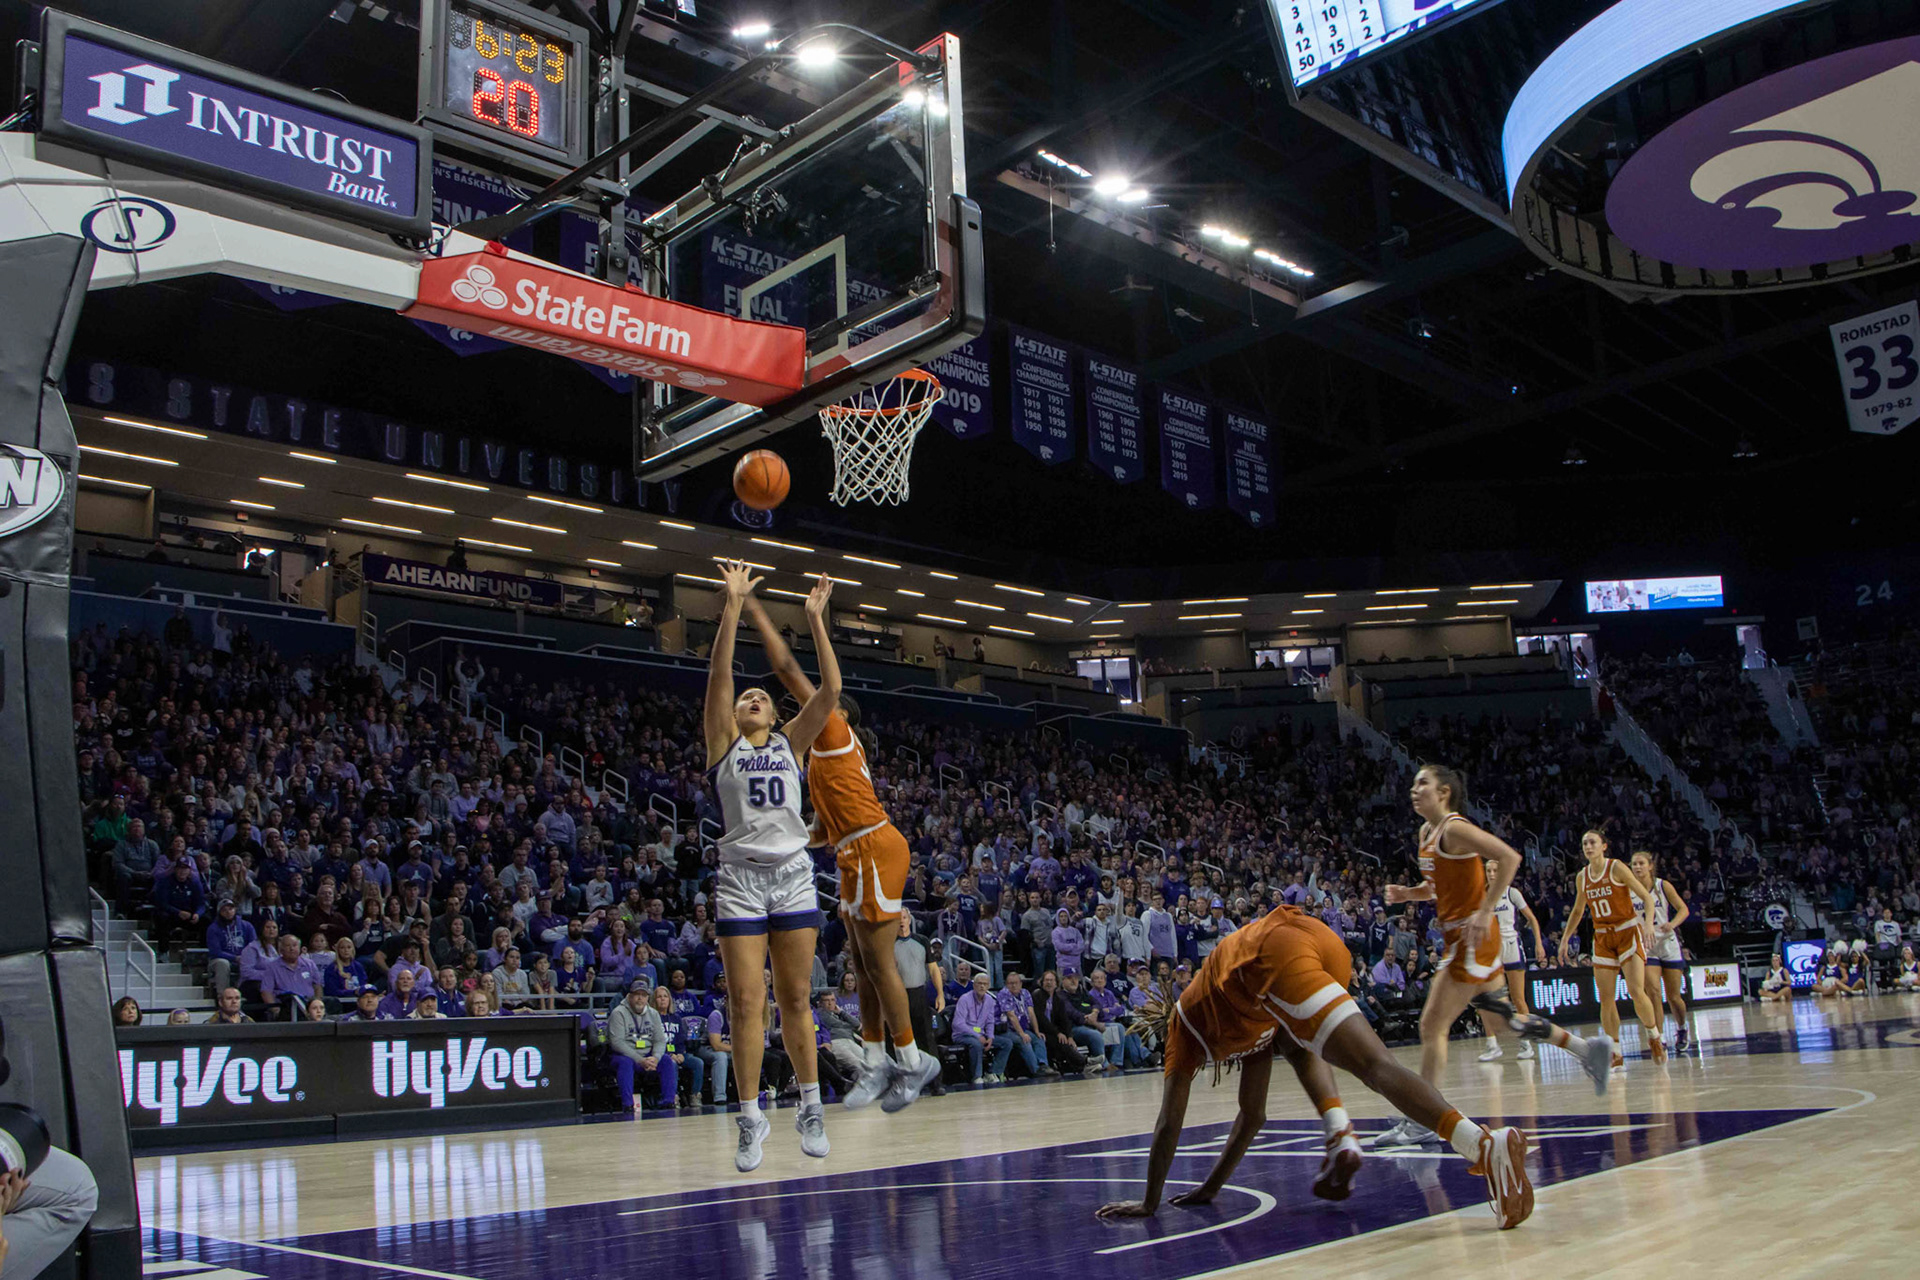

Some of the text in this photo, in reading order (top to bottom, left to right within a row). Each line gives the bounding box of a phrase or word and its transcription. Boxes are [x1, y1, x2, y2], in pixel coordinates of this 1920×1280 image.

[1291, 5, 1369, 22] 3 10 2
[1295, 22, 1373, 40] 4 3 2
[1295, 37, 1345, 55] 12 15
[1299, 53, 1315, 71] 50
[473, 67, 539, 137] 20
[186, 91, 391, 181] INTRUST
[326, 172, 389, 207] Bank
[453, 172, 518, 200] BASKETBALL
[1840, 314, 1910, 343] ROMSTAD
[1014, 335, 1067, 363] K-STATE
[927, 361, 990, 388] CHAMPIONS
[1021, 362, 1065, 383] CONFERENCE
[1089, 360, 1137, 386] K-STATE
[1844, 334, 1919, 400] 33
[1016, 369, 1071, 392] CHAMPIONSHIPS
[1023, 386, 1064, 406] 1917 1951
[1096, 385, 1135, 405] CONFERENCE
[1162, 392, 1208, 417] K-STATE
[167, 379, 340, 448] STATE
[1023, 398, 1065, 418] 1919 1956
[1024, 408, 1041, 421] 1948
[1864, 397, 1913, 417] 1979-82
[1025, 420, 1067, 440] 1950 1959
[1227, 413, 1268, 437] K-STATE
[1243, 440, 1257, 453] NIT
[292, 533, 306, 543] 20
[1855, 581, 1894, 606] 24
[748, 776, 785, 807] 50
[1586, 885, 1613, 899] TEXAS
[1591, 899, 1612, 918] 10
